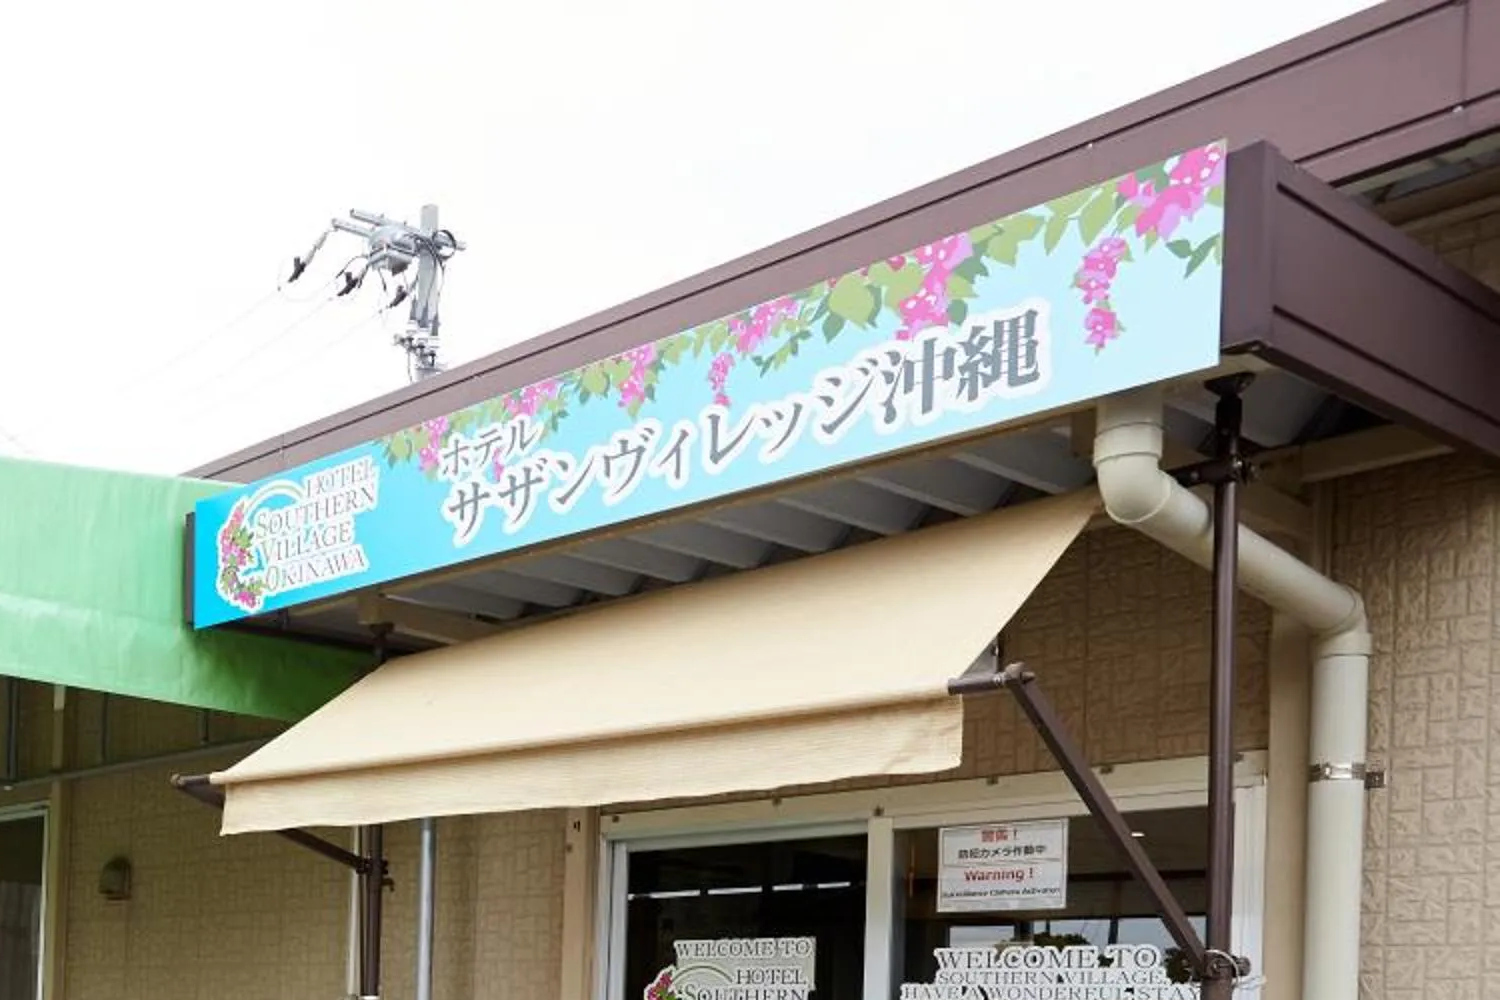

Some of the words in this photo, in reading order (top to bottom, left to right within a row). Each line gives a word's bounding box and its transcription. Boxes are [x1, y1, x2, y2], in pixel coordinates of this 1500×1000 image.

[446, 308, 1041, 538] サザンヴィレッジ沖縄
[441, 418, 537, 474] ホテル
[307, 458, 375, 497] HOTEL
[257, 485, 375, 538] SOUTHERN
[262, 520, 352, 562] VILLAGE
[267, 548, 365, 590] OKINAWA
[677, 941, 773, 957] WELCOME
[780, 940, 809, 955] TO
[937, 951, 1099, 969] WELCOME
[1110, 949, 1157, 967] TO
[737, 969, 806, 985] HOTEL
[905, 986, 959, 999] HAVE
[967, 986, 984, 1000] A
[987, 985, 1129, 1000] WONDERFUL
[1137, 986, 1200, 1000] STAY
[938, 971, 1058, 985] SOUTHERN
